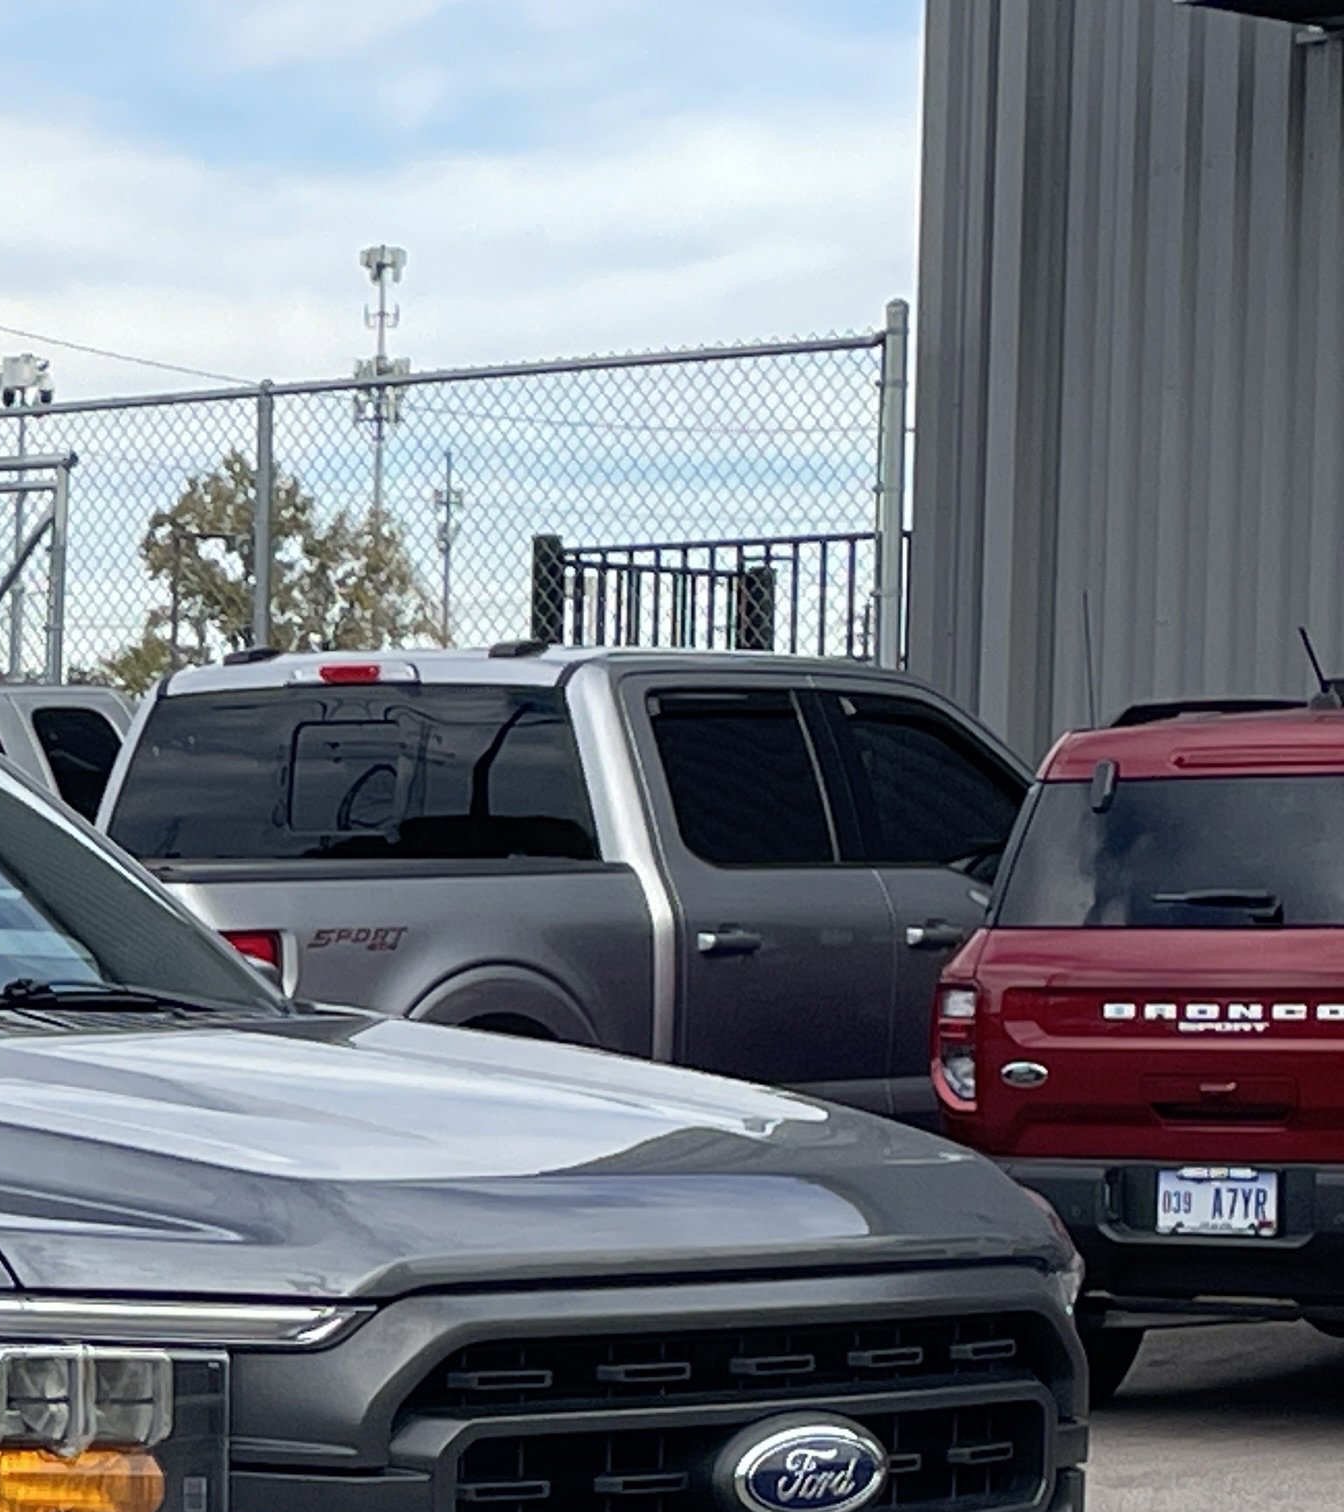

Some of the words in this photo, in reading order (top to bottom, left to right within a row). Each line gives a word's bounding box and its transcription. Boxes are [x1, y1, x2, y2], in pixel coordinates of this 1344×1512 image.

[306, 926, 408, 950] SPORT
[1103, 1002, 1344, 1021] BRONCO
[1162, 1189, 1192, 1214] 039
[1212, 1187, 1268, 1220] A7YR
[777, 1448, 857, 1502] Ford
